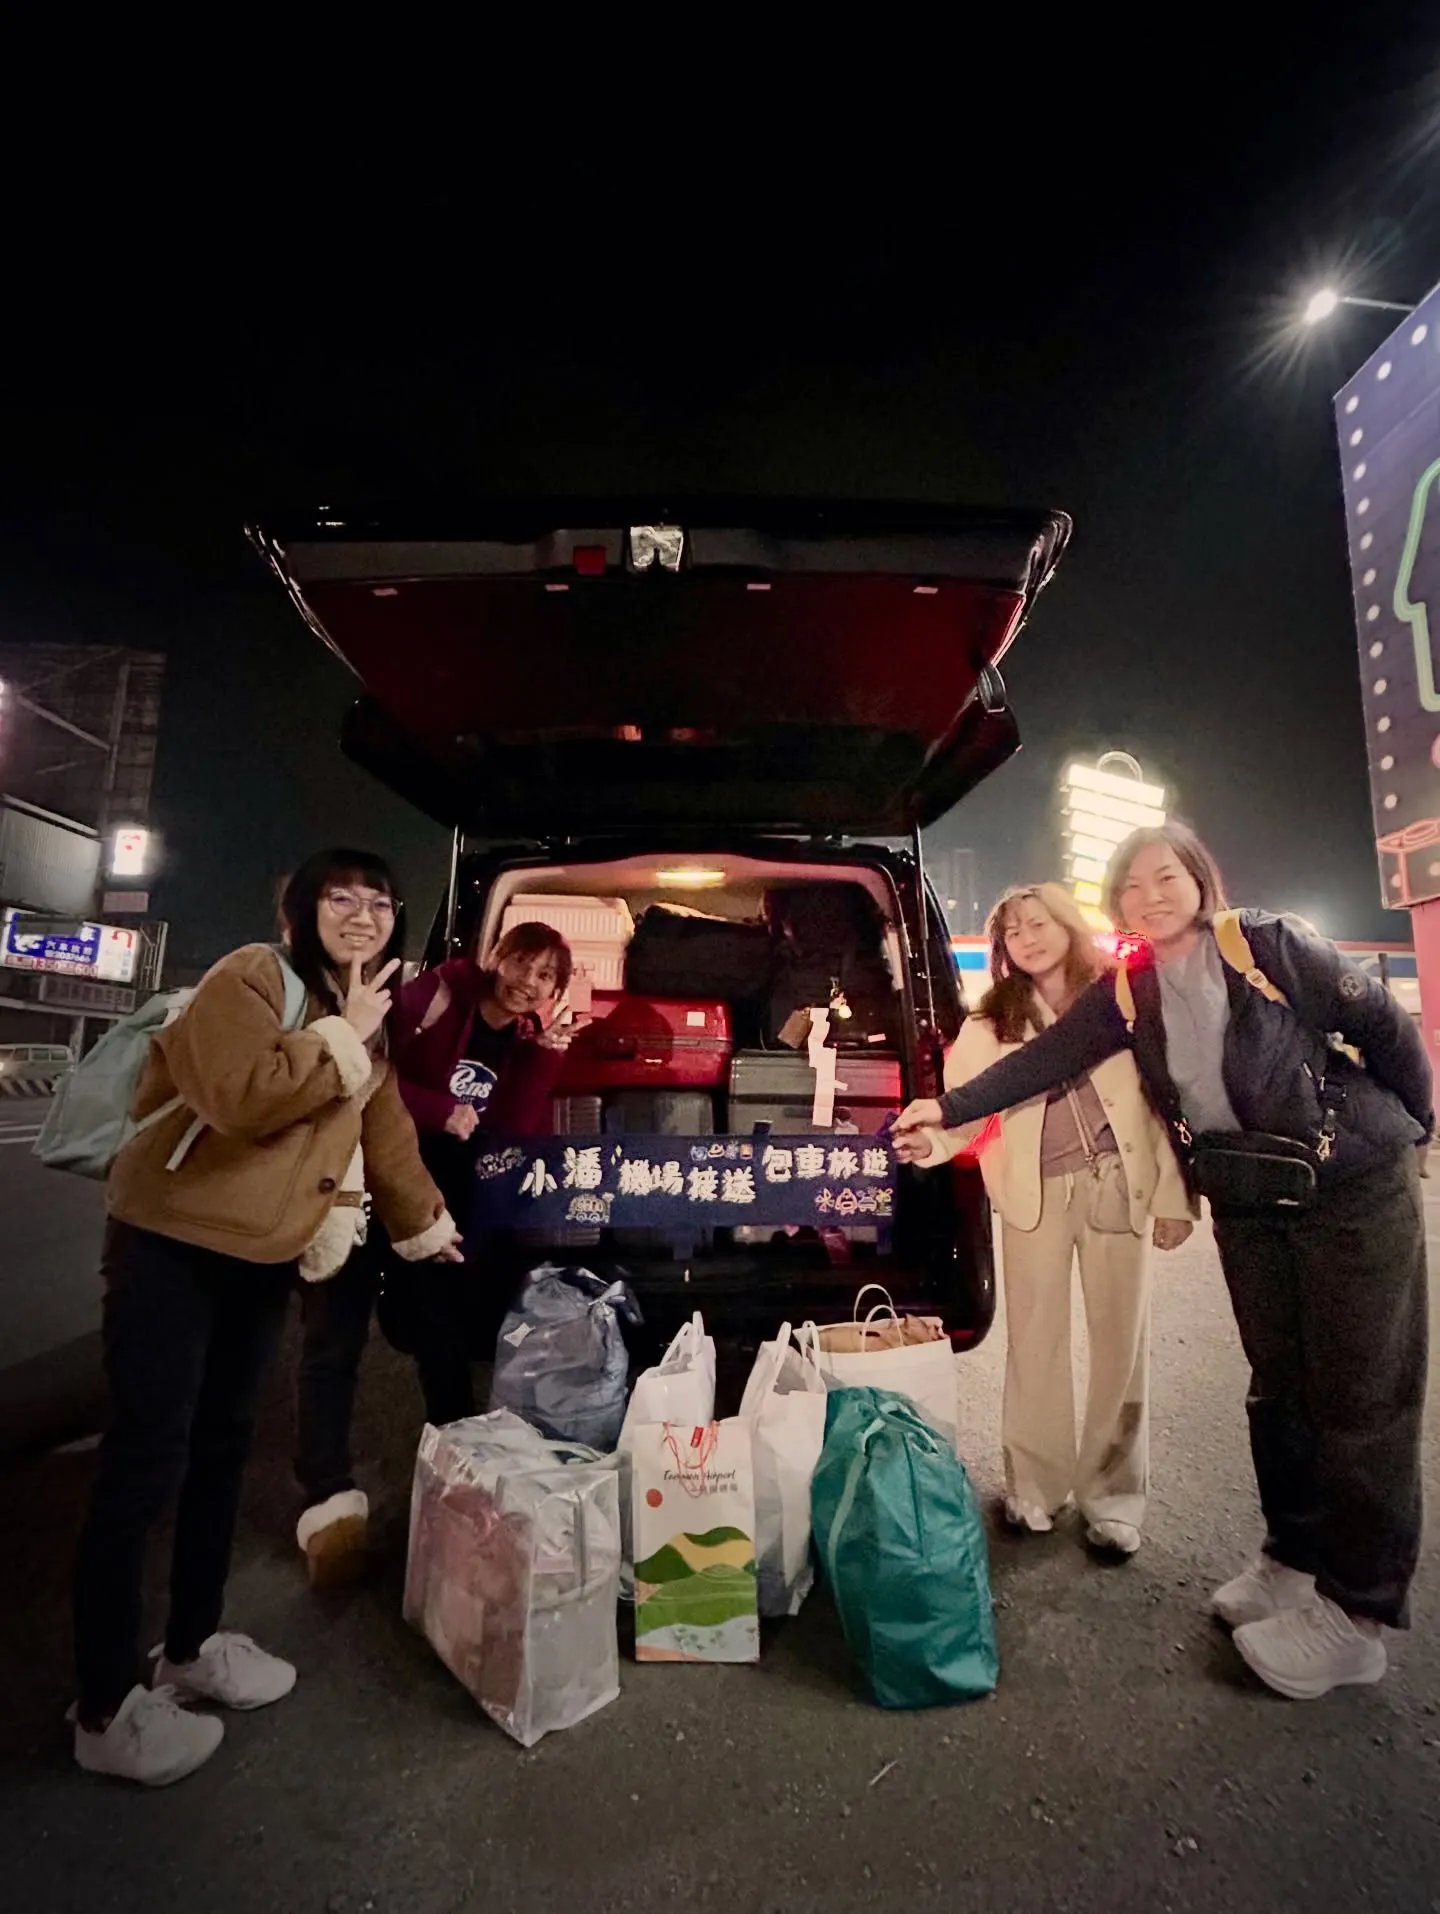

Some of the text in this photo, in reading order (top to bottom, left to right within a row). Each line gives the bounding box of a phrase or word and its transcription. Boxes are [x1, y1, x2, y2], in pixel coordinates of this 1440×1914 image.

[518, 1144, 889, 1203] 小潘 機場接送 包車旅遊
